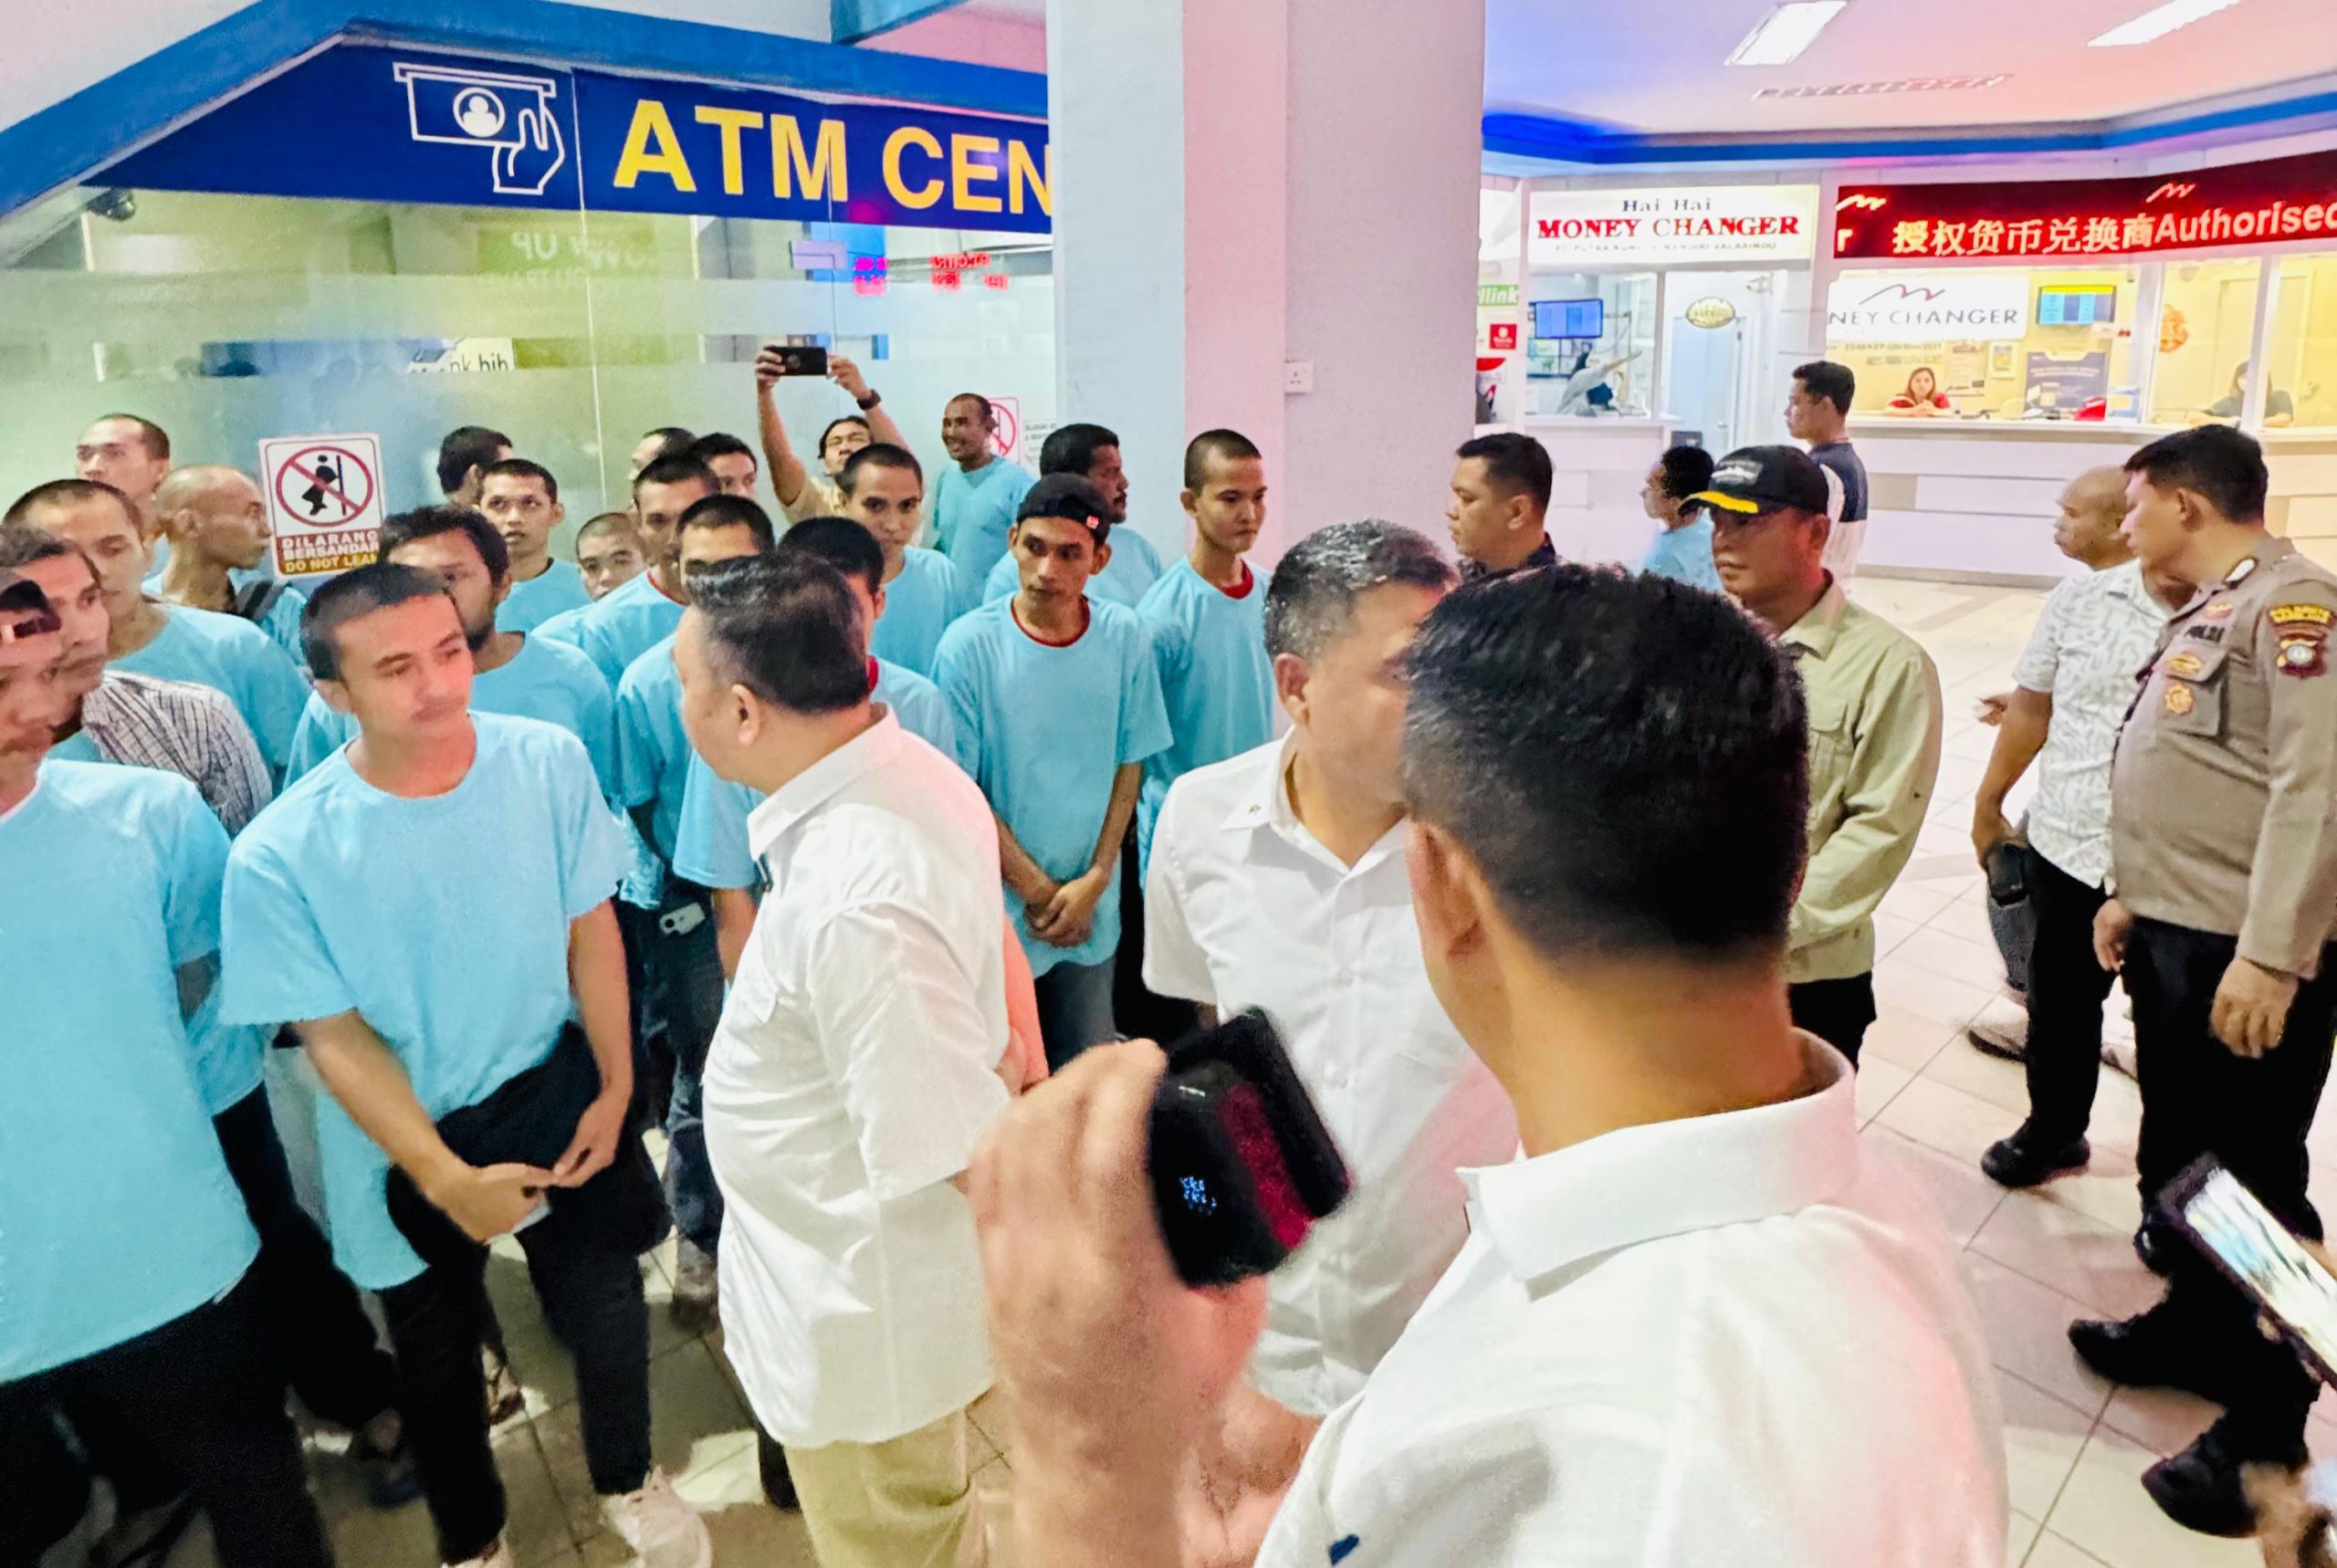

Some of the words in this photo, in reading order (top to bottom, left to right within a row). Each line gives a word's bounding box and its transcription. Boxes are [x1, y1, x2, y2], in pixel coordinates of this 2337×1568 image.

[613, 99, 848, 203] ATM
[882, 126, 1052, 215] CEN
[1622, 199, 1659, 212] Hai
[1673, 198, 1712, 211] Hai
[1537, 219, 1642, 238] MONEY
[1652, 216, 1800, 237] CHANGER
[1892, 213, 2155, 256] 授权货币兑换商
[1827, 311, 1879, 325] NEY
[1890, 308, 2018, 325] CHANGER
[281, 530, 378, 549] DILARANG
[285, 560, 307, 573] DO
[309, 557, 341, 570] NOT
